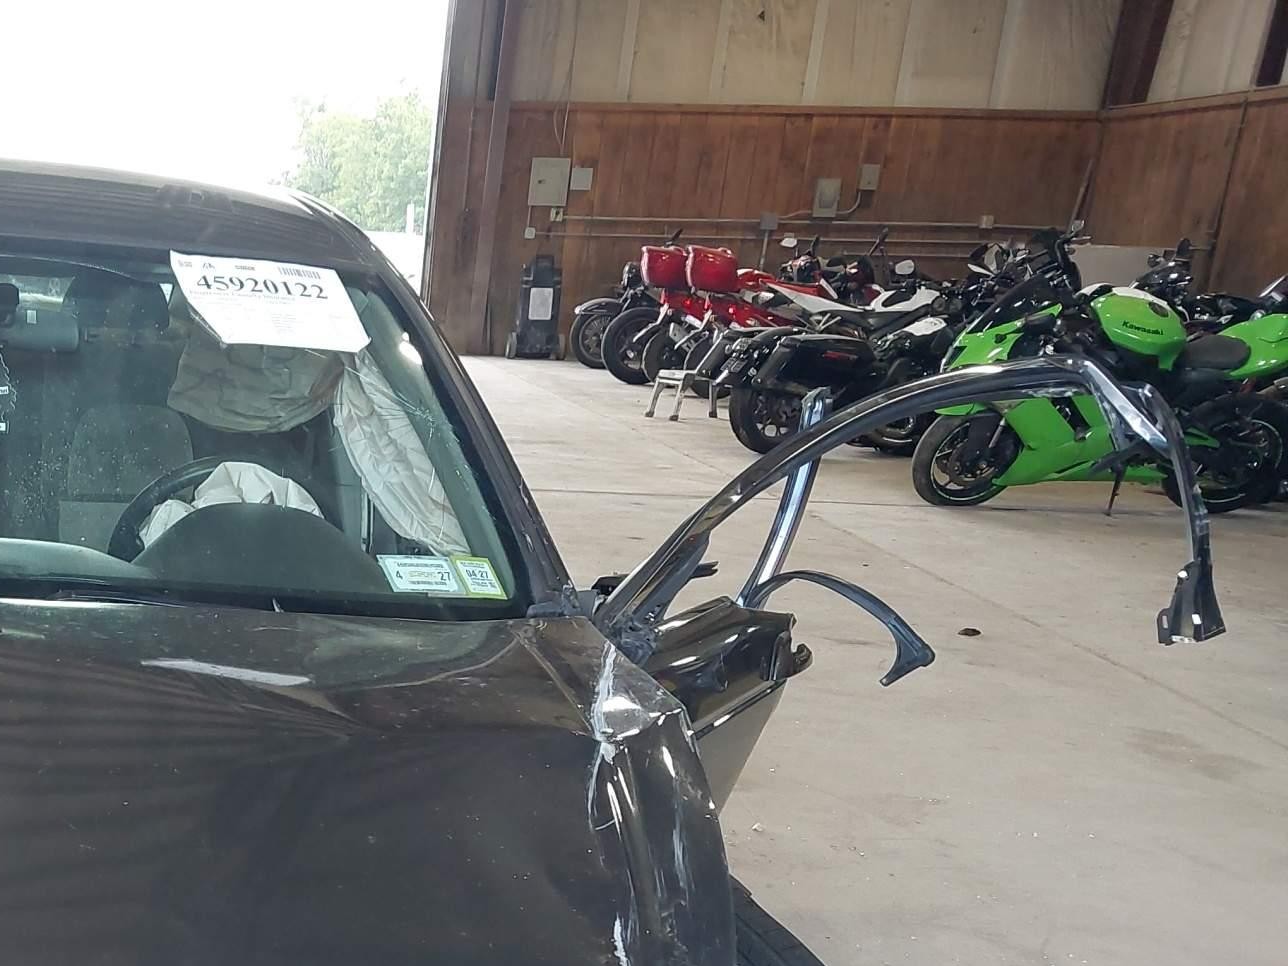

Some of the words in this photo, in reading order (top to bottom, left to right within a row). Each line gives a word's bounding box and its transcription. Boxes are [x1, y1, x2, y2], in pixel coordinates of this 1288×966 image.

[196, 274, 329, 300] 45920122
[1122, 320, 1163, 335] Kawasaki
[438, 571, 451, 582] 27
